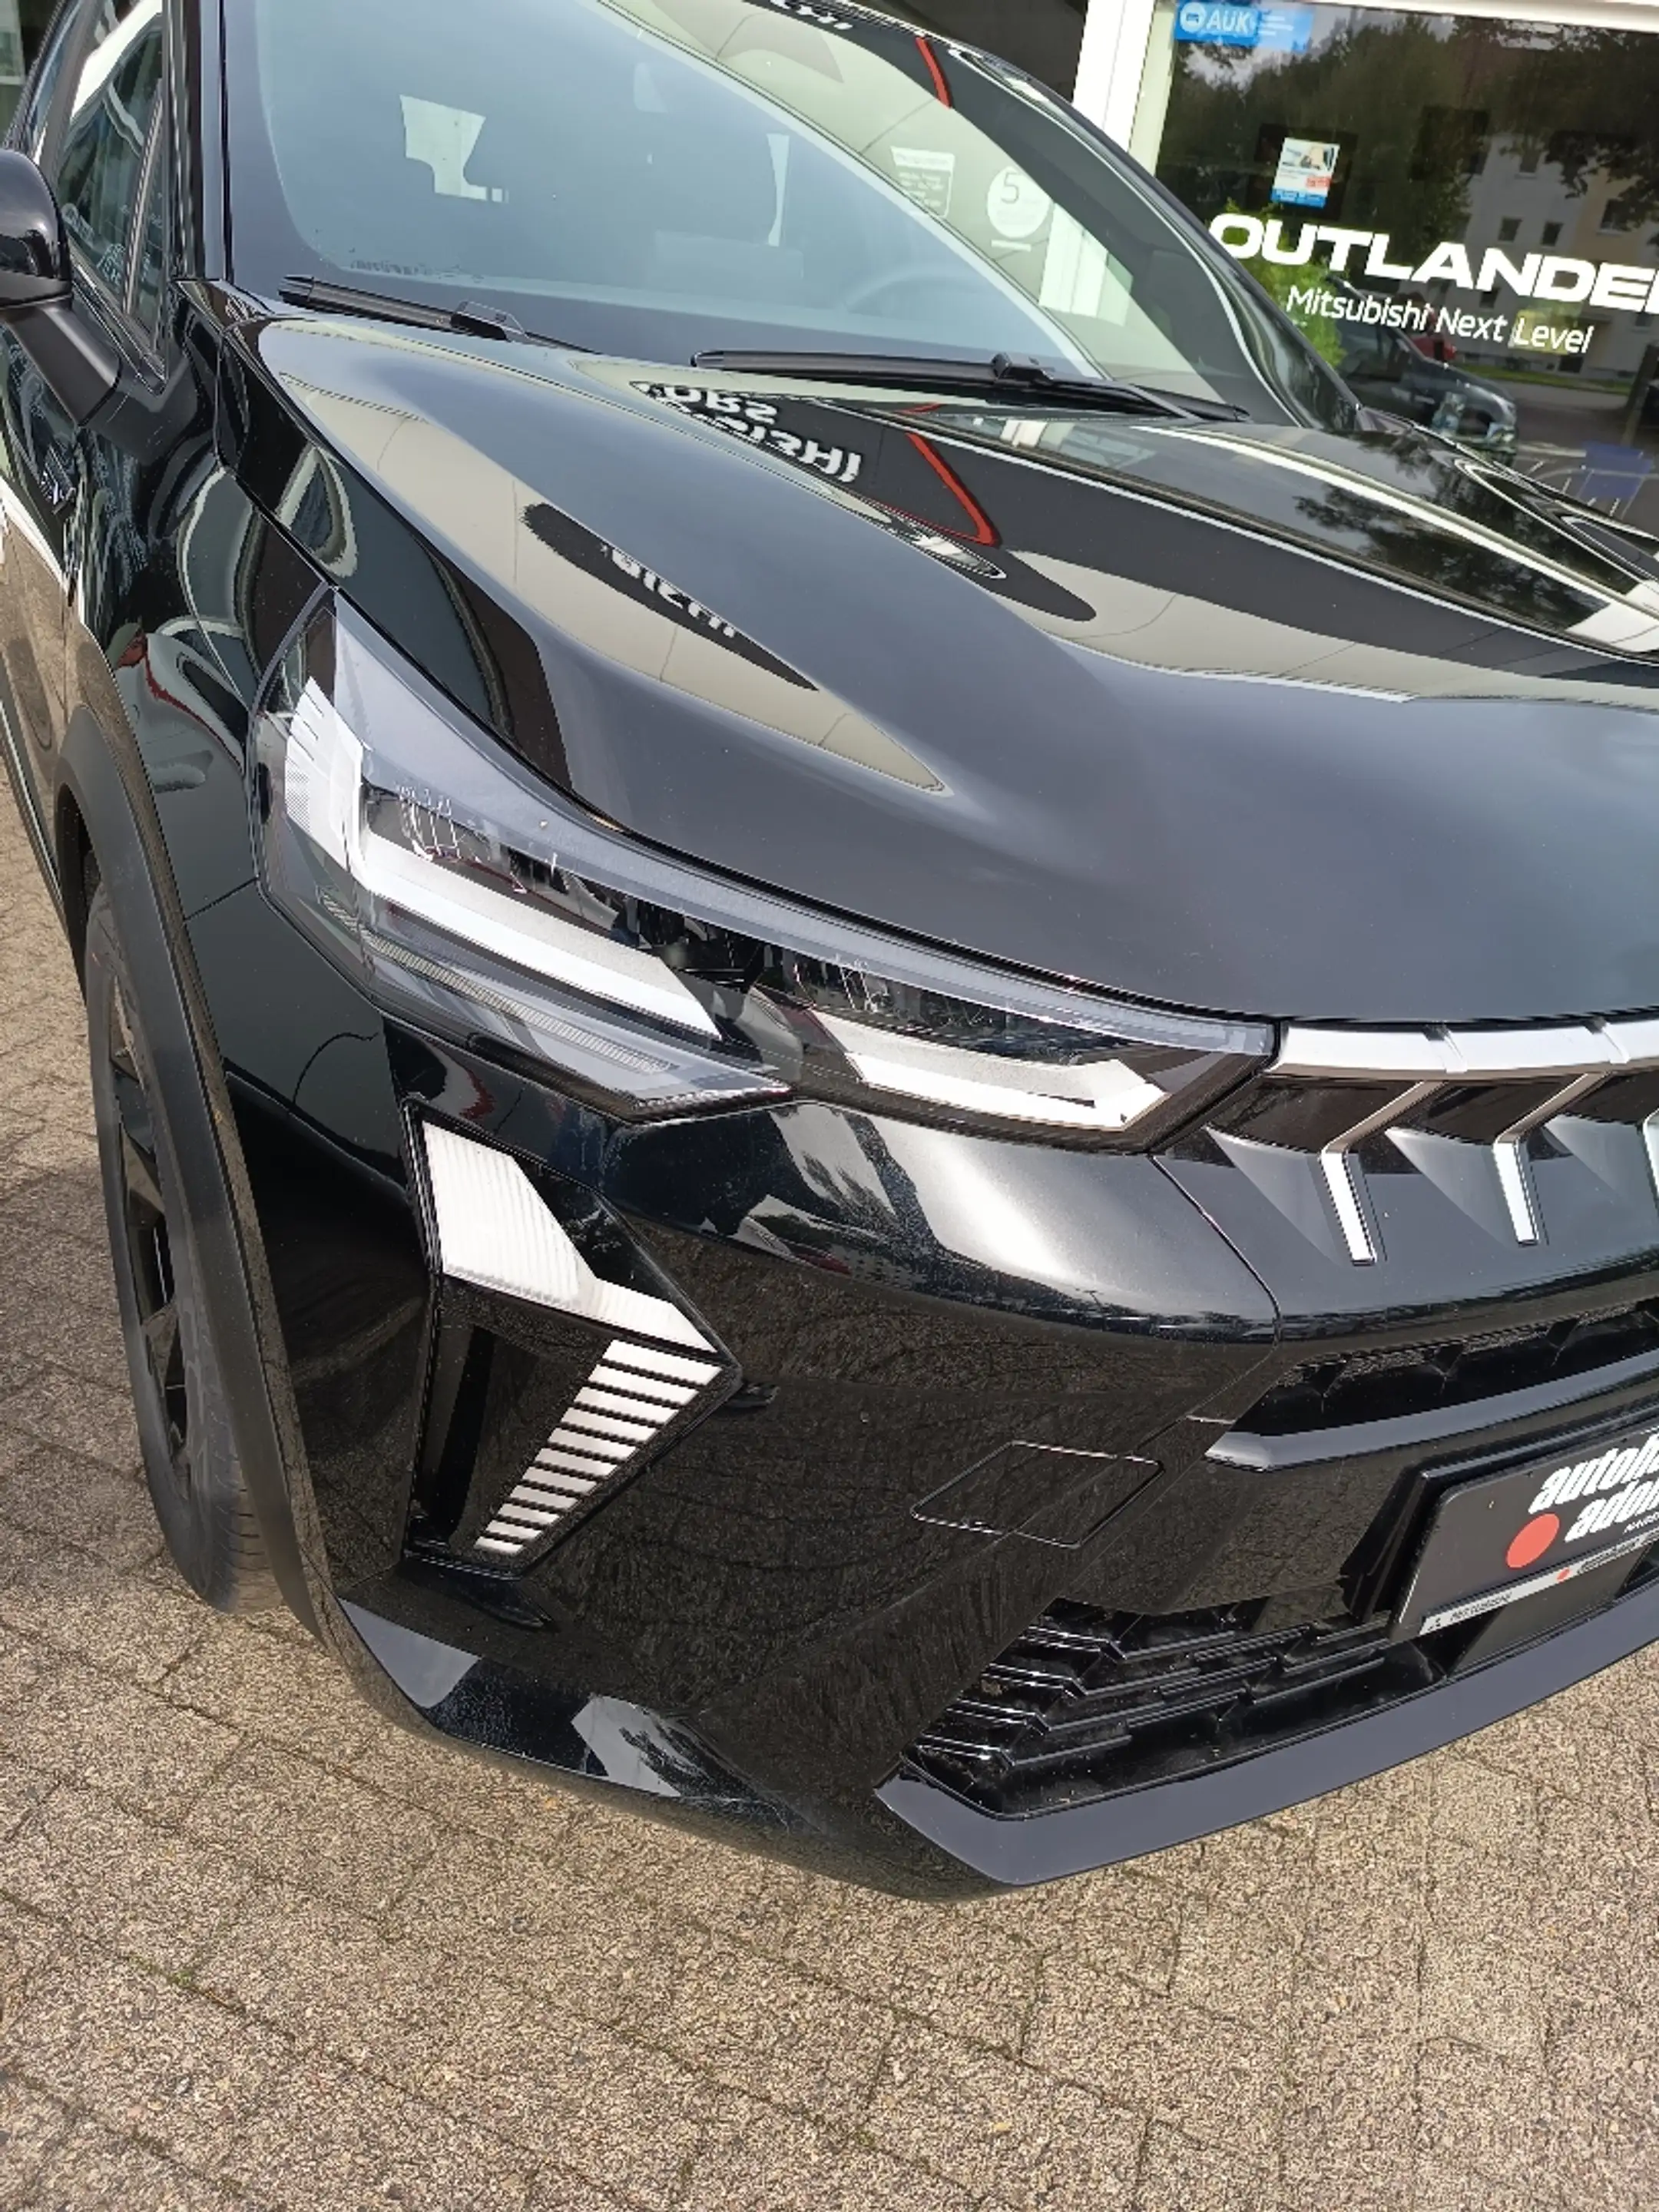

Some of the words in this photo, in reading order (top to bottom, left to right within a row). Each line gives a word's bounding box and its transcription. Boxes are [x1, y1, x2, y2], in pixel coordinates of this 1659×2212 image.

[1001, 172, 1020, 204] 5
[1208, 212, 1659, 315] OUTLANDE
[1286, 284, 1432, 332] Mitsubishi
[1434, 306, 1508, 343] Next
[1512, 317, 1594, 354] Level
[1528, 1430, 1659, 1515] autoh
